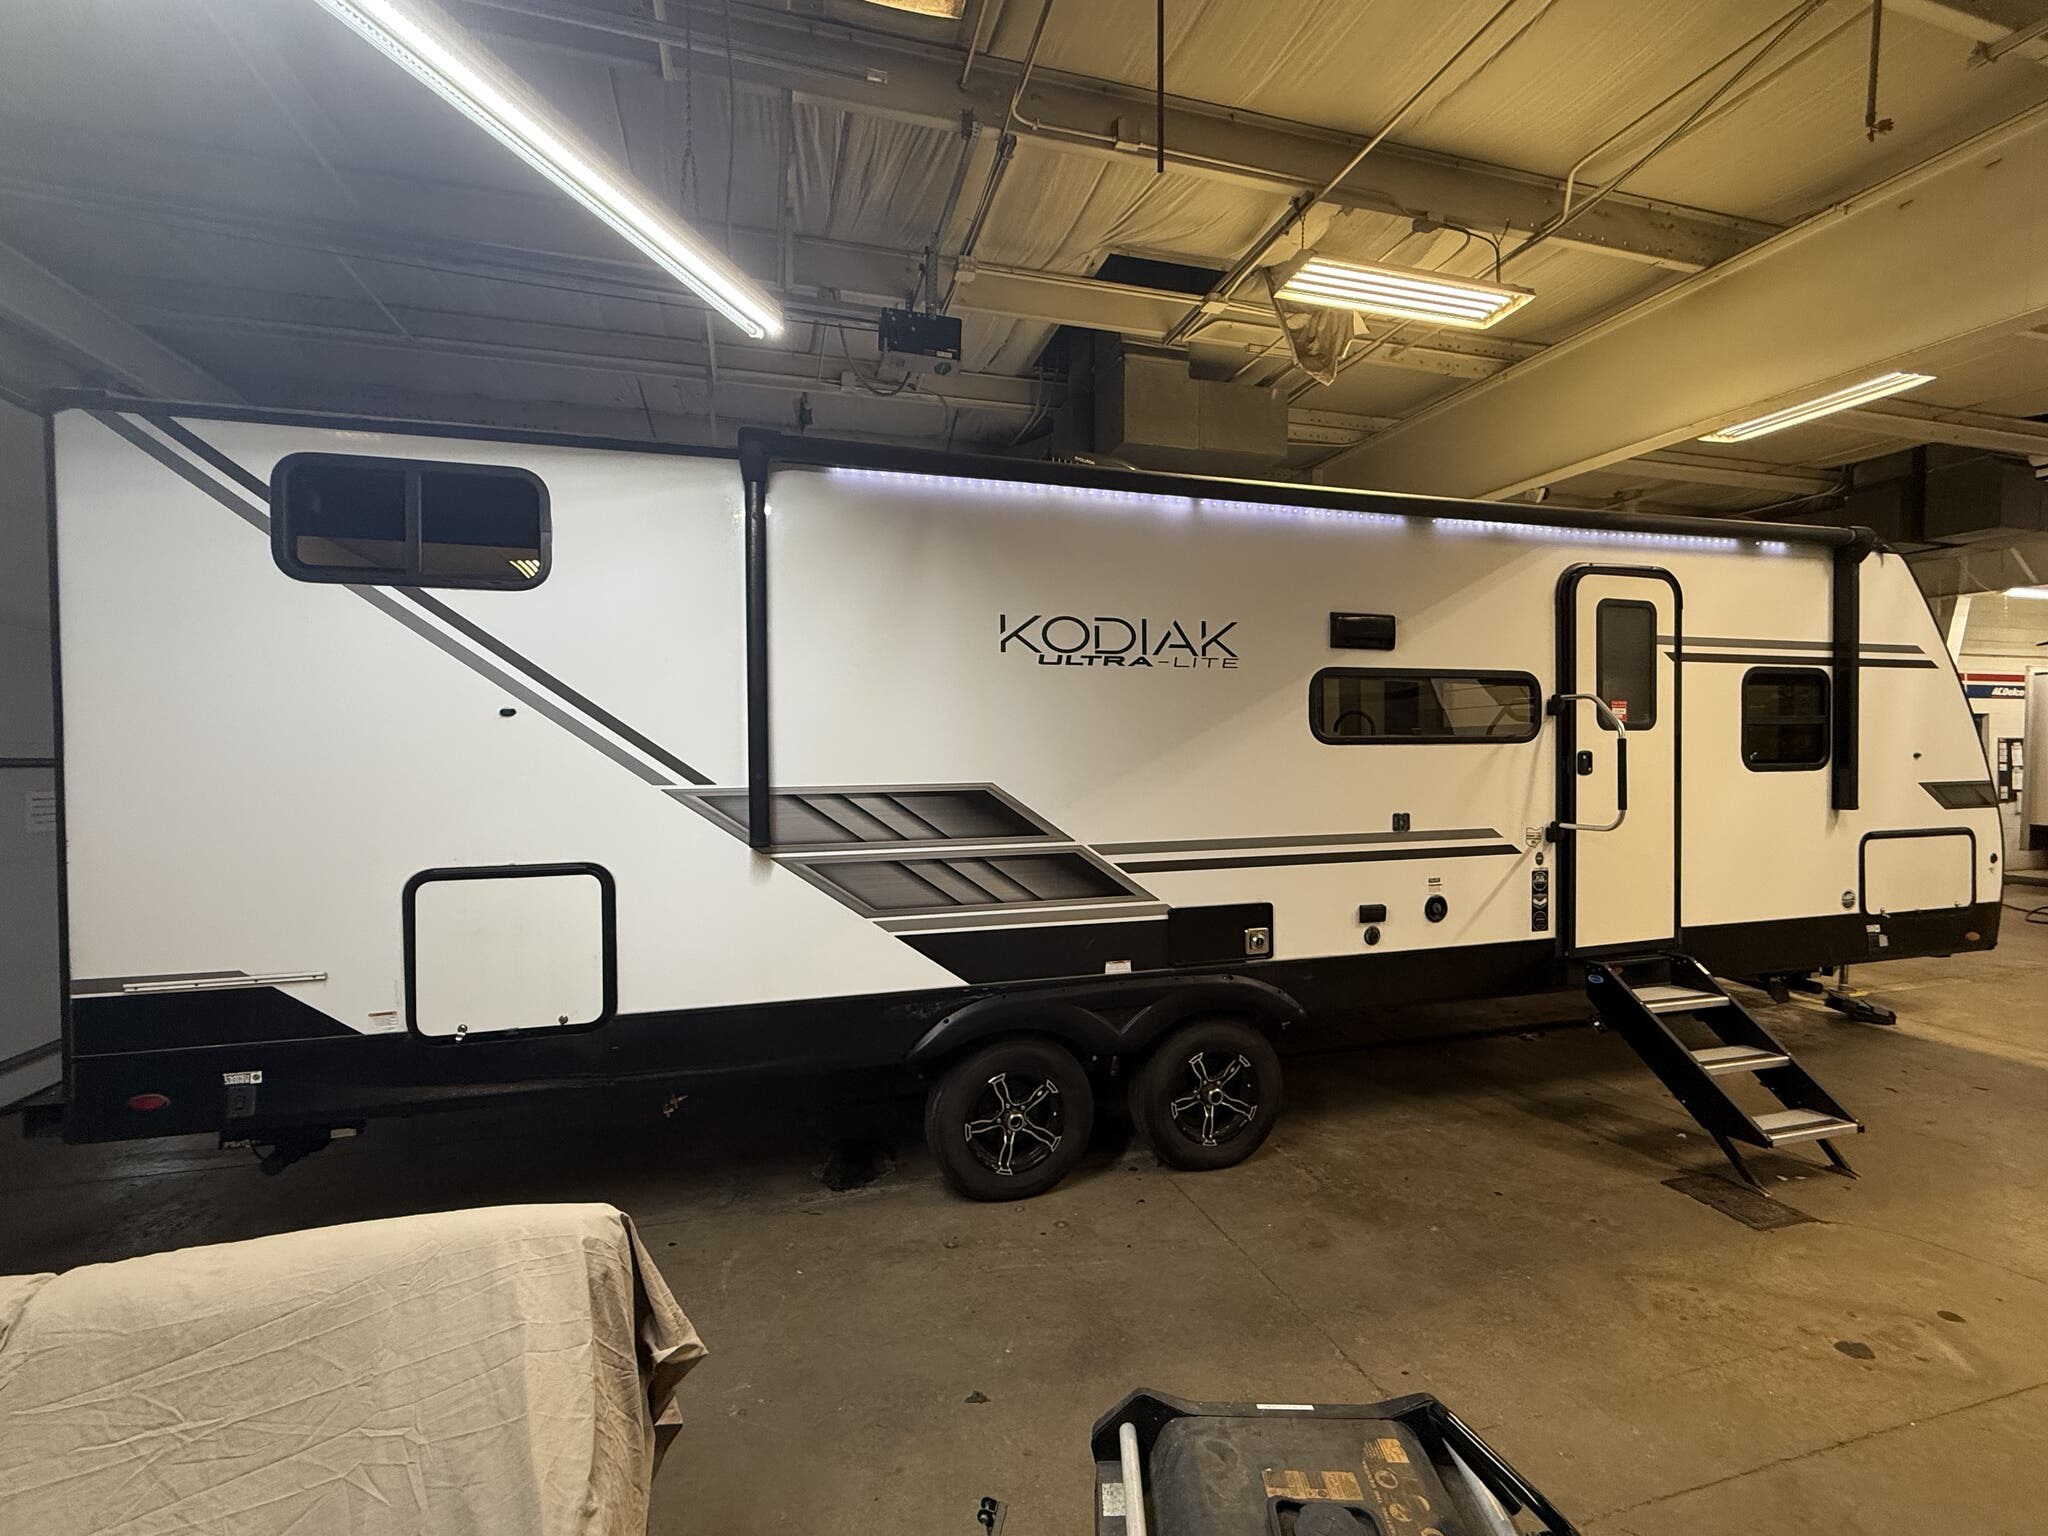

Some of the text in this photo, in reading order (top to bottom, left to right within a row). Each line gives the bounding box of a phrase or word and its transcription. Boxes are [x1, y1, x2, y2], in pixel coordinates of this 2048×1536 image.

[1000, 613, 1238, 657] KODIAK
[1038, 653, 1239, 669] ULTRA-LITE
[1992, 687, 2025, 697] ACDelco
